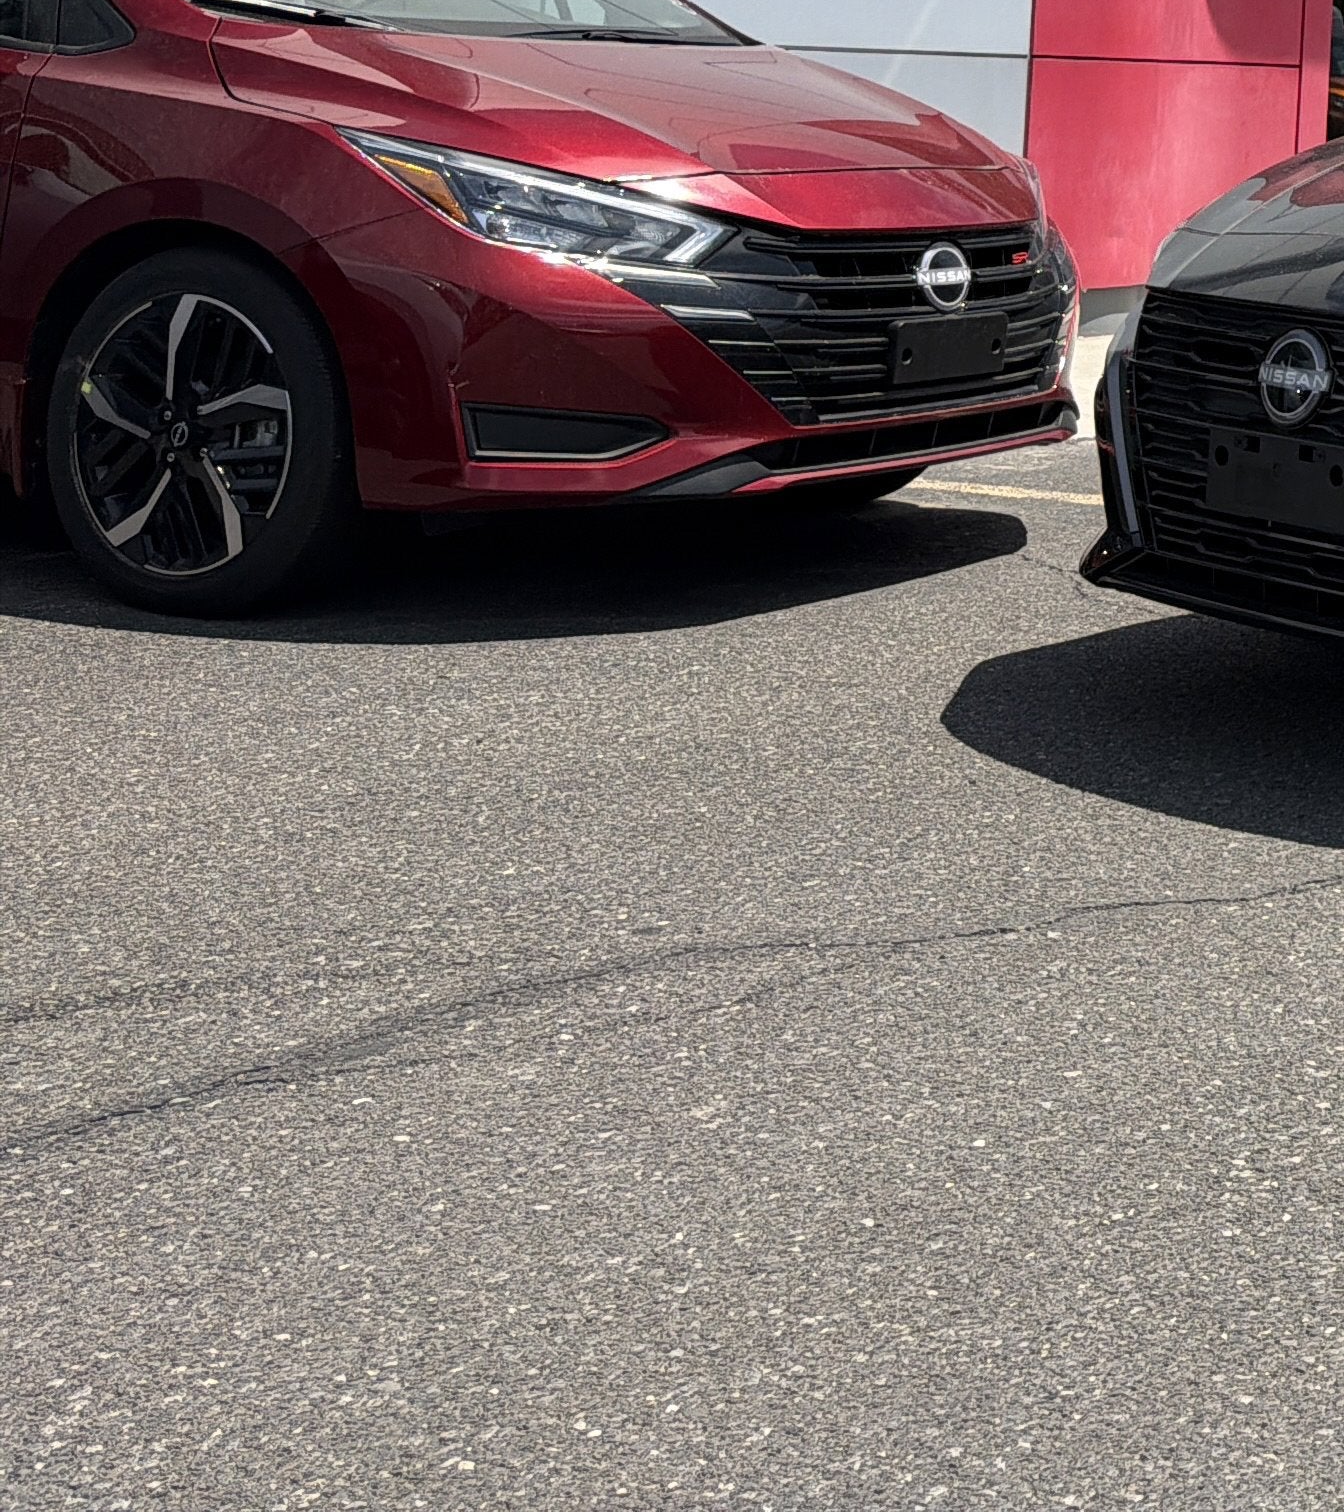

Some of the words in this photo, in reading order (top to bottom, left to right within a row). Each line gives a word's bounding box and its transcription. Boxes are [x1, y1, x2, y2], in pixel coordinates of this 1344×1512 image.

[1012, 251, 1029, 265] SR
[917, 270, 972, 284] NISSAN
[1258, 367, 1329, 389] NISSAN
